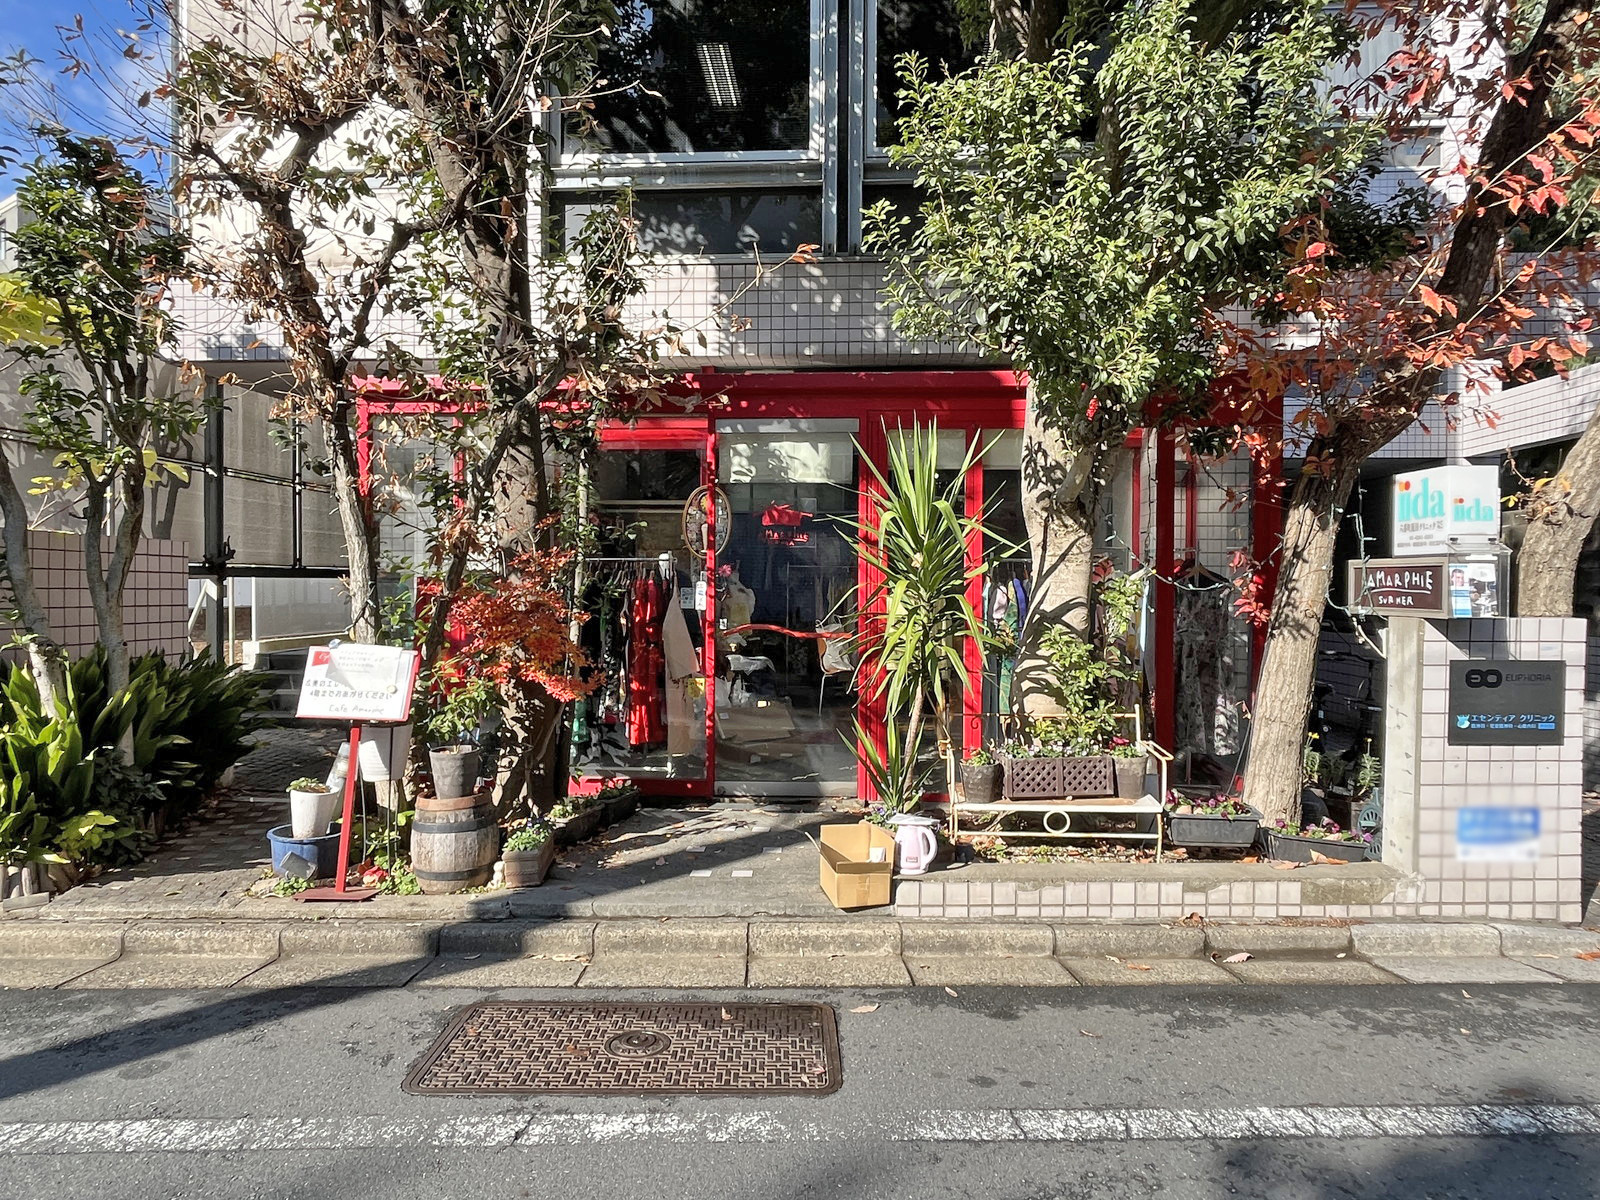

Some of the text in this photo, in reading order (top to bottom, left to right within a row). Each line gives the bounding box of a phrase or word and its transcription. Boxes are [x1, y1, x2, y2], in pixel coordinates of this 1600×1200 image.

[1453, 498, 1494, 522] iida
[1367, 570, 1433, 590] AMARPHIE
[1505, 673, 1551, 682] EUPHORIA
[1471, 714, 1556, 722] エセンティア クリニック
